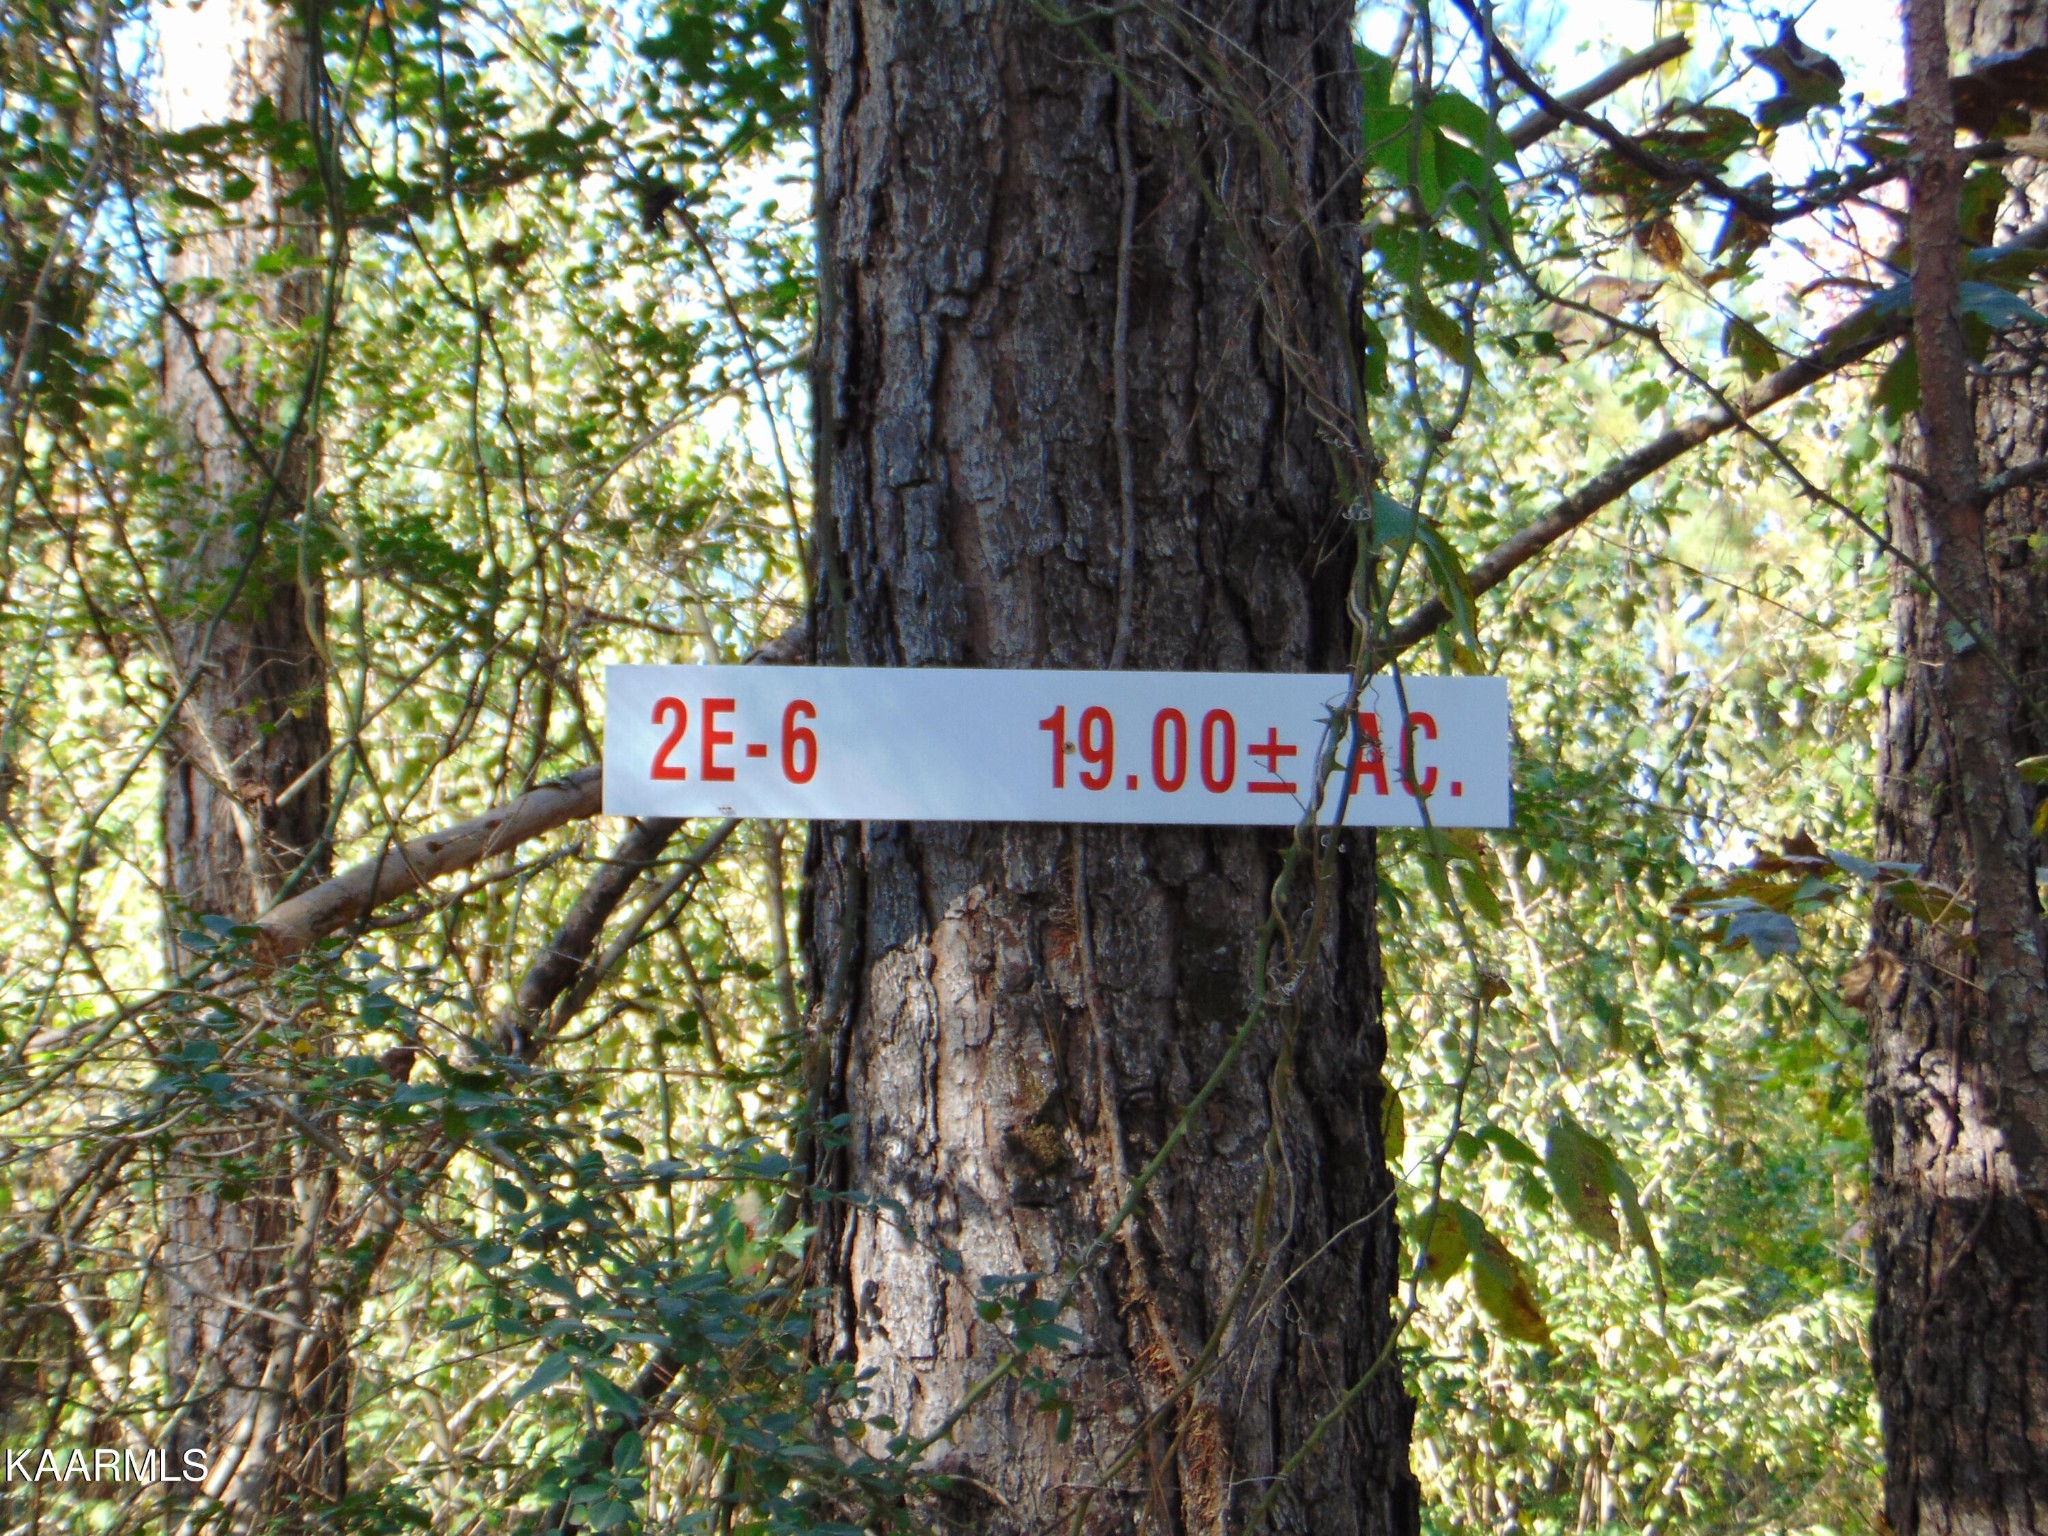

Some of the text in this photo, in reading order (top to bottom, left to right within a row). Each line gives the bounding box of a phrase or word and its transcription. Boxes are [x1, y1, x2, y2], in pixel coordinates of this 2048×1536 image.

[650, 696, 1464, 797] 2E-6 19.00± AC.
